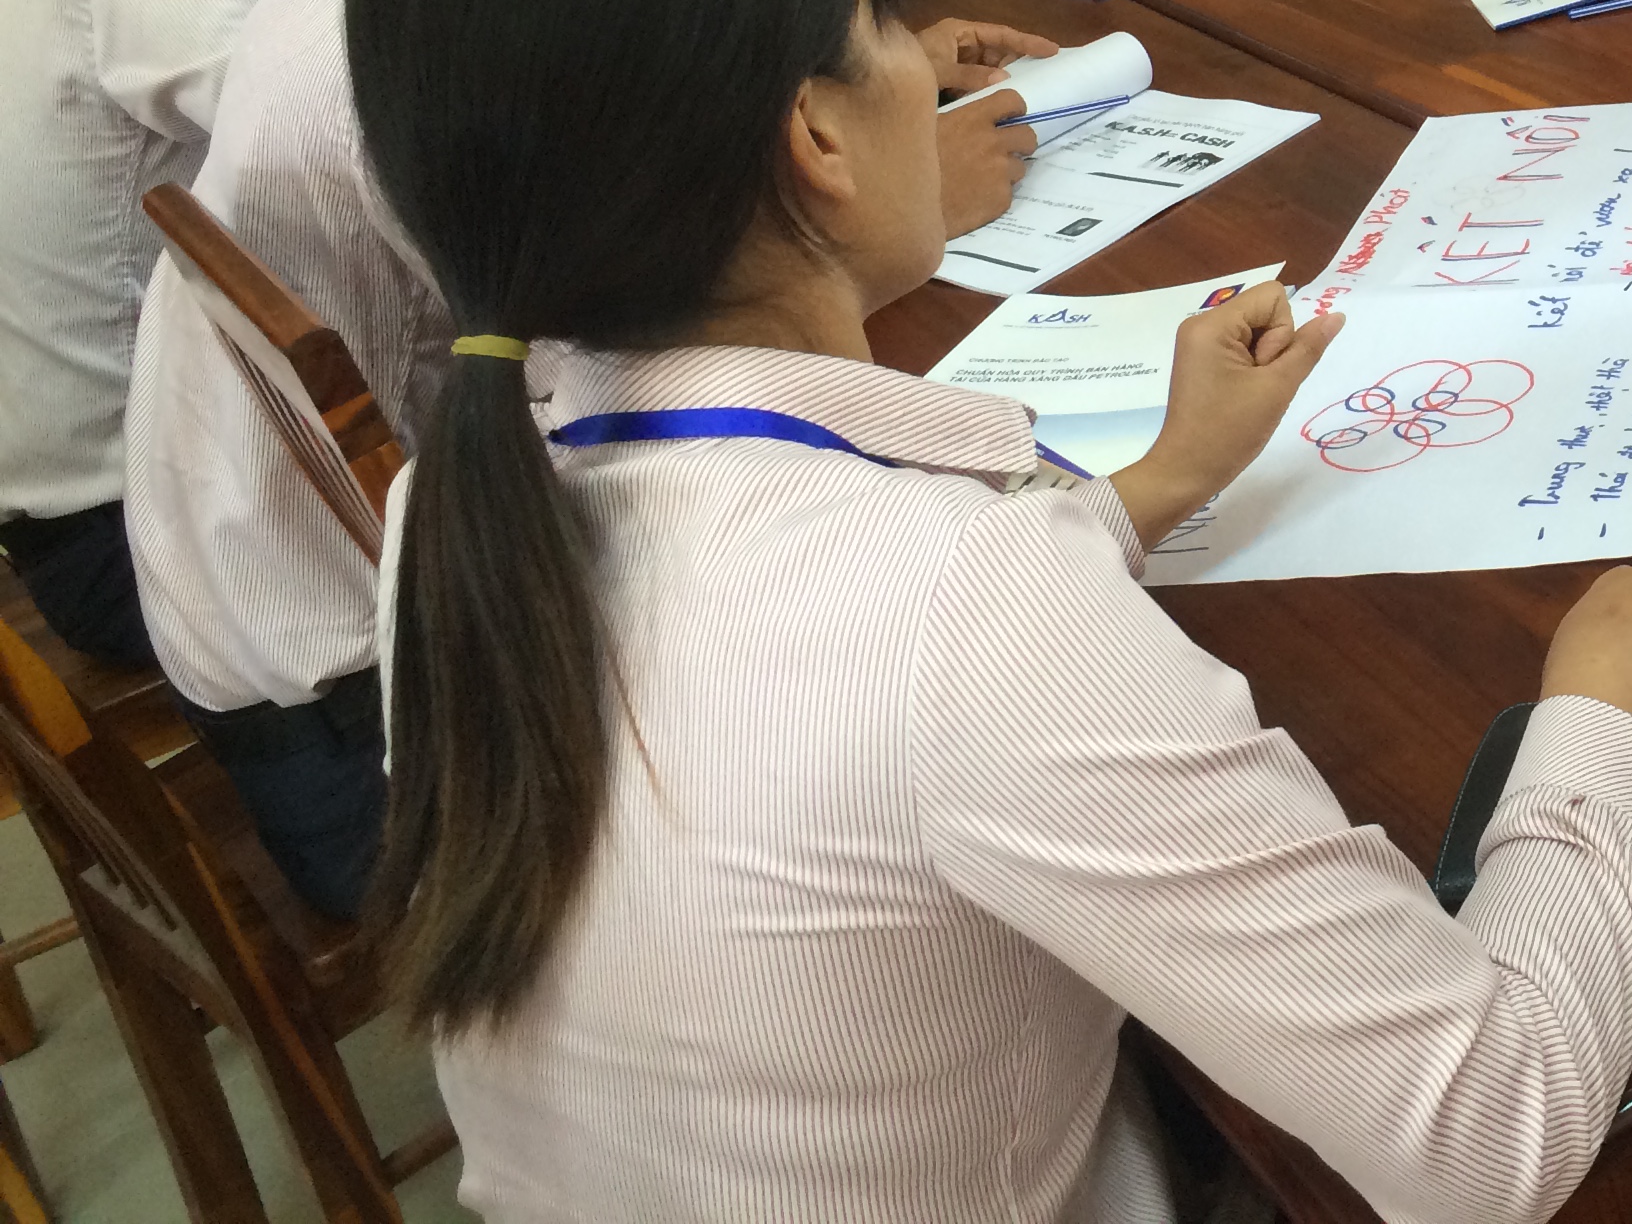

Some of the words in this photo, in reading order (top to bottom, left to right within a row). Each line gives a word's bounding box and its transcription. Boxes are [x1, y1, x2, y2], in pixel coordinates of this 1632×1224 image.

[1179, 132, 1236, 148] CASH
[1411, 212, 1544, 287] KẾT
[1496, 114, 1590, 181] NỐI
[1088, 368, 1161, 381] PETROLIMEX
[1518, 461, 1585, 507] Trung
